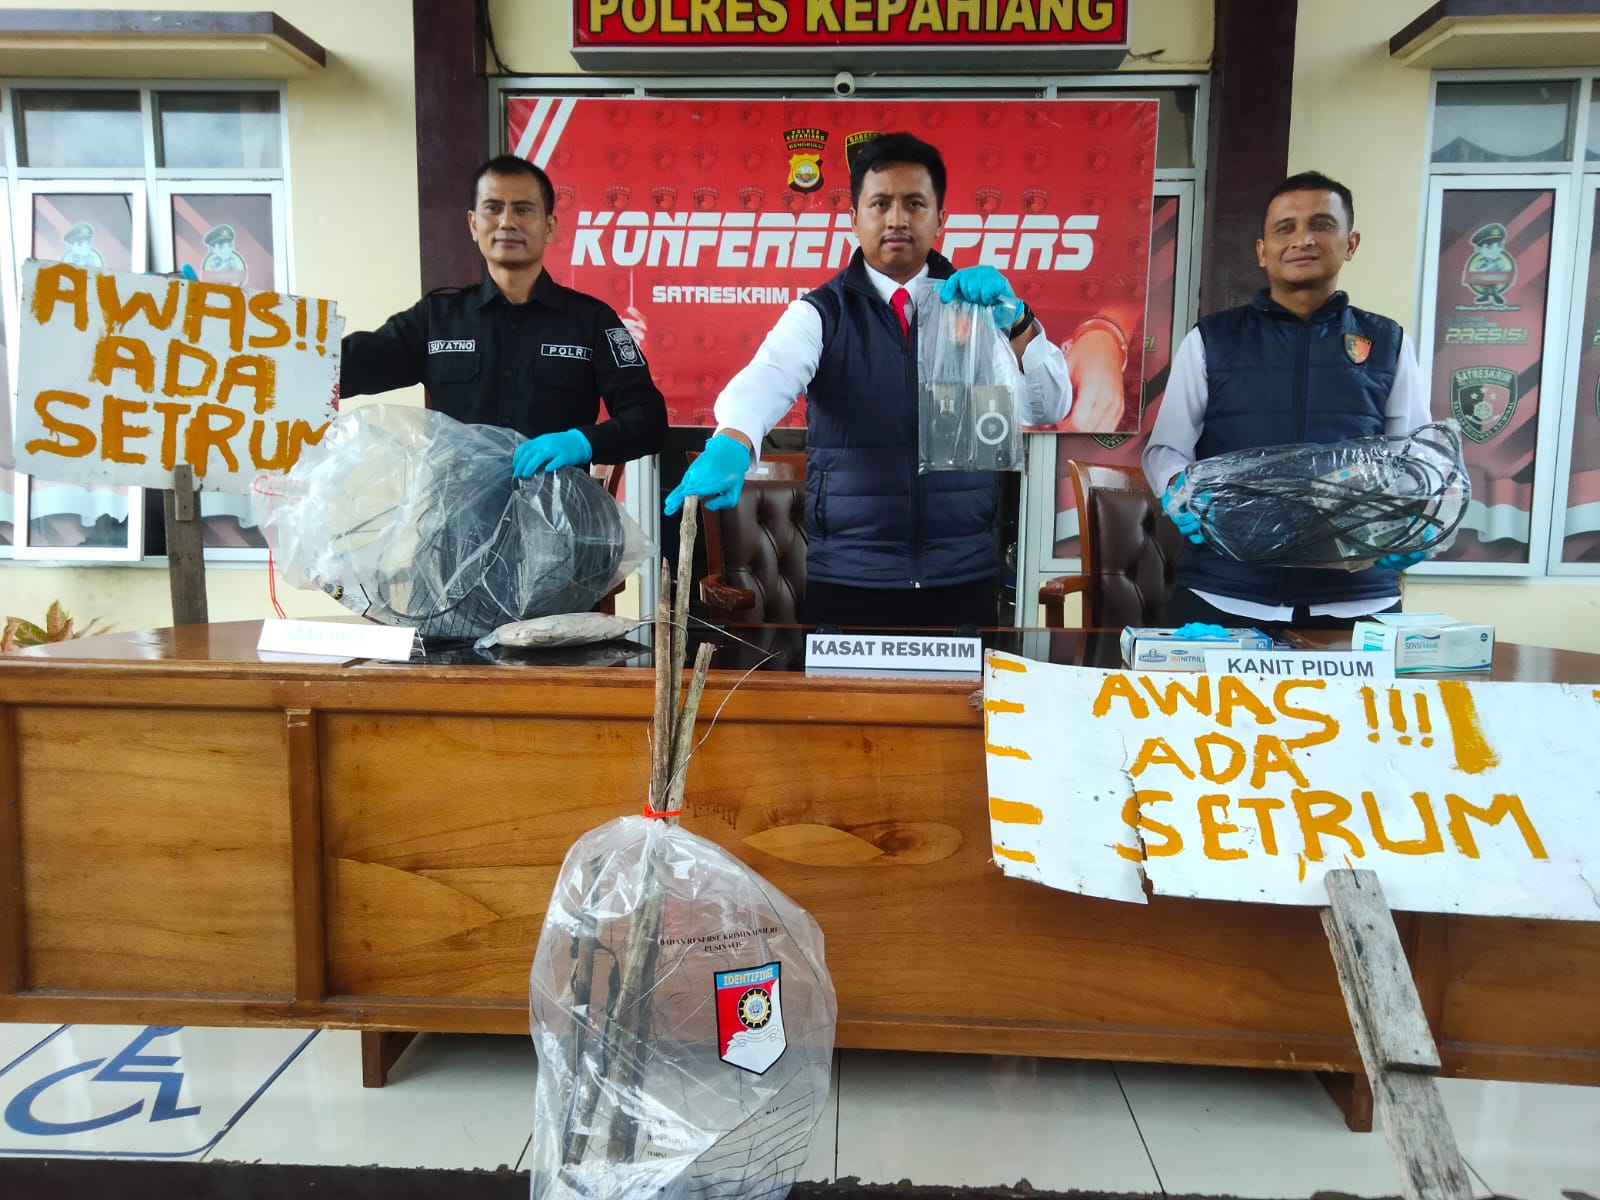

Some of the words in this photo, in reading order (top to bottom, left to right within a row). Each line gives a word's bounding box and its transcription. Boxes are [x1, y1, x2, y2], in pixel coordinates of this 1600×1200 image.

[589, 0, 788, 33] POLRES
[806, 0, 1114, 33] KEPAHIANG
[570, 211, 861, 268] KONFEREN
[941, 214, 1099, 270] PERS
[652, 285, 789, 304] SATRESKRIM
[31, 263, 328, 356] AWAS!!
[430, 341, 473, 351] SUYATNO
[1446, 328, 1528, 342] PRESISI
[549, 346, 587, 358] POLRI
[88, 336, 276, 414] ADA
[812, 640, 875, 656] KASAT
[881, 642, 975, 658] RESKRIM
[1228, 658, 1294, 675] KANIT
[1302, 660, 1374, 677] PIDUM
[1129, 732, 1310, 789] ADA
[1113, 788, 1549, 863] SETRUM
